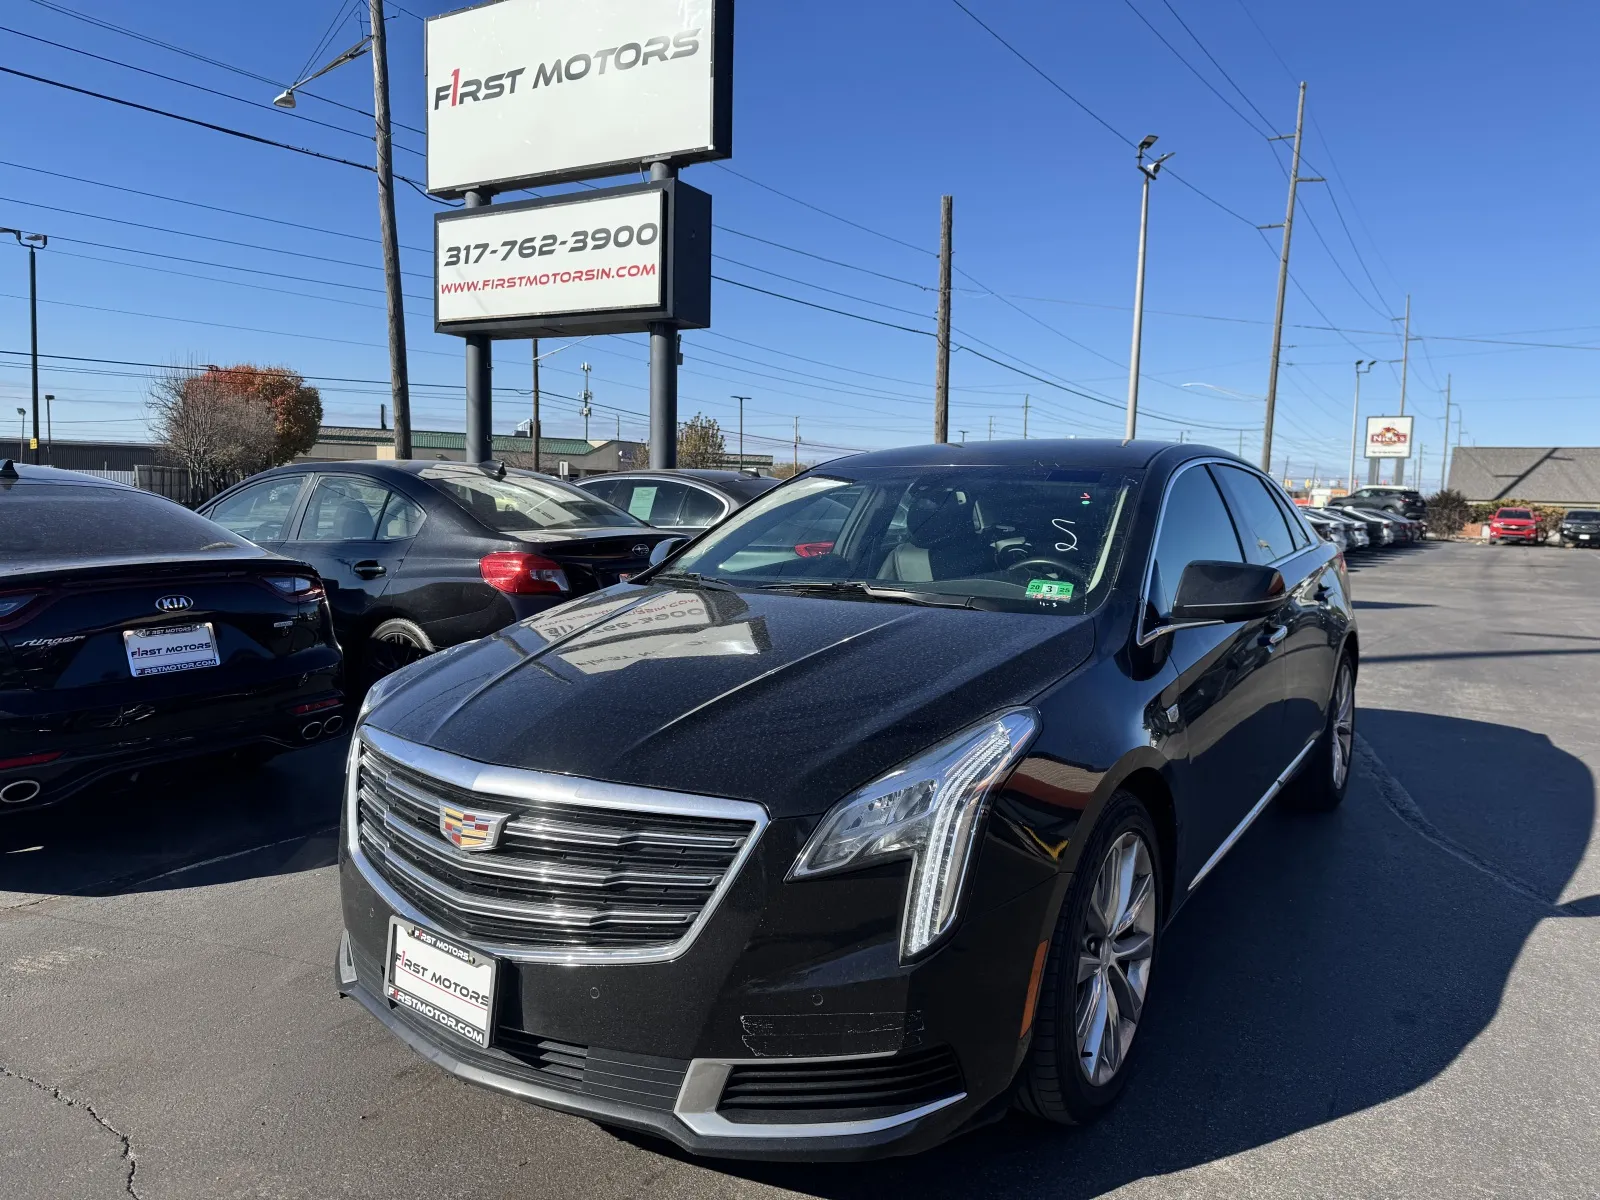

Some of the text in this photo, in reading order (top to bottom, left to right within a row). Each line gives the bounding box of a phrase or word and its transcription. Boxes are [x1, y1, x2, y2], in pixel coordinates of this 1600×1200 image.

[532, 28, 701, 89] MOTORS
[444, 222, 658, 266] 317-762-3900
[440, 263, 656, 294] WWW.FIRSTMOTORSIN.COM
[162, 597, 188, 609] KIA
[166, 642, 211, 653] MOTORS
[436, 941, 469, 960] MOTORS
[430, 972, 489, 1006] MOTORS
